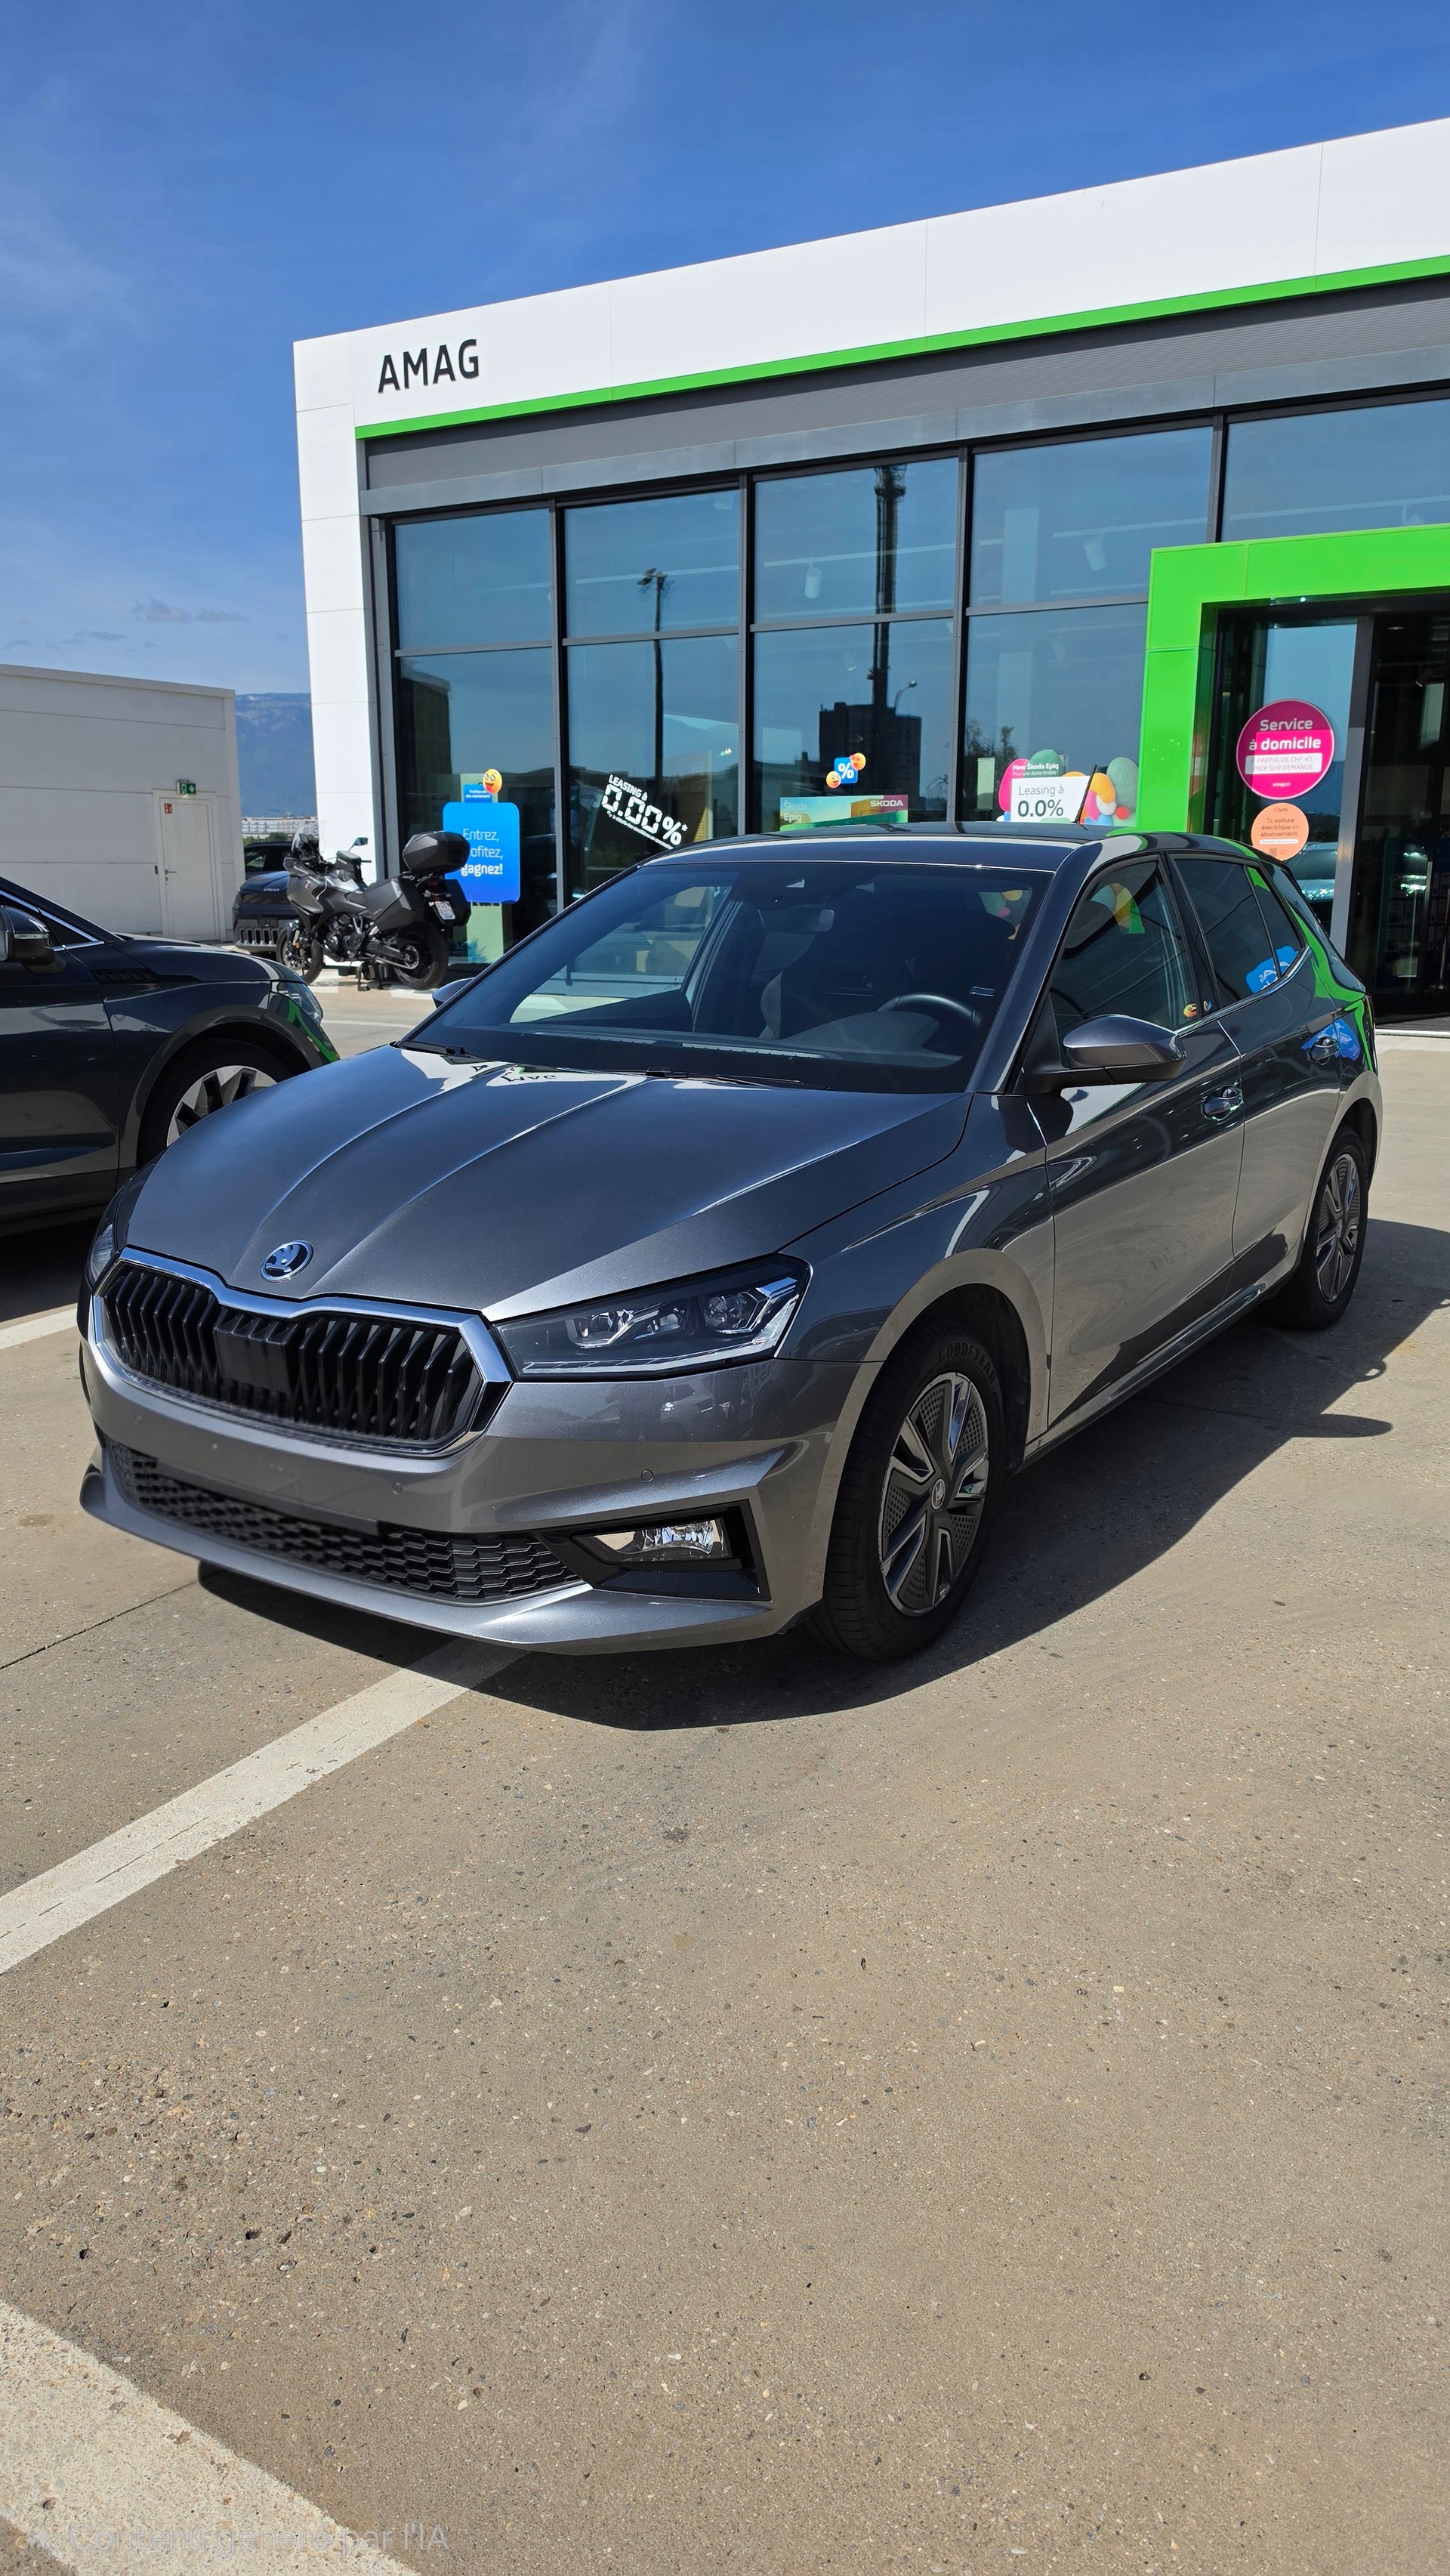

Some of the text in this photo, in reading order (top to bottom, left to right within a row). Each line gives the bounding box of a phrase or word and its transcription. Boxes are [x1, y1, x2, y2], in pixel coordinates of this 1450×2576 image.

[378, 339, 480, 394] AMAG
[1260, 718, 1313, 731] Service
[1248, 736, 1322, 750] à domicile
[1046, 762, 1059, 771] Epiq
[608, 774, 643, 798] LEASING
[1019, 784, 1064, 797] Leasing à
[783, 800, 807, 811] Škoda
[1017, 798, 1064, 817] 0.0%
[783, 813, 803, 823] Epiq
[463, 828, 500, 843] Entrez,
[470, 845, 504, 860] ofitez,
[461, 863, 503, 877] gagnez!
[938, 1341, 998, 1387] GOODYEAR
